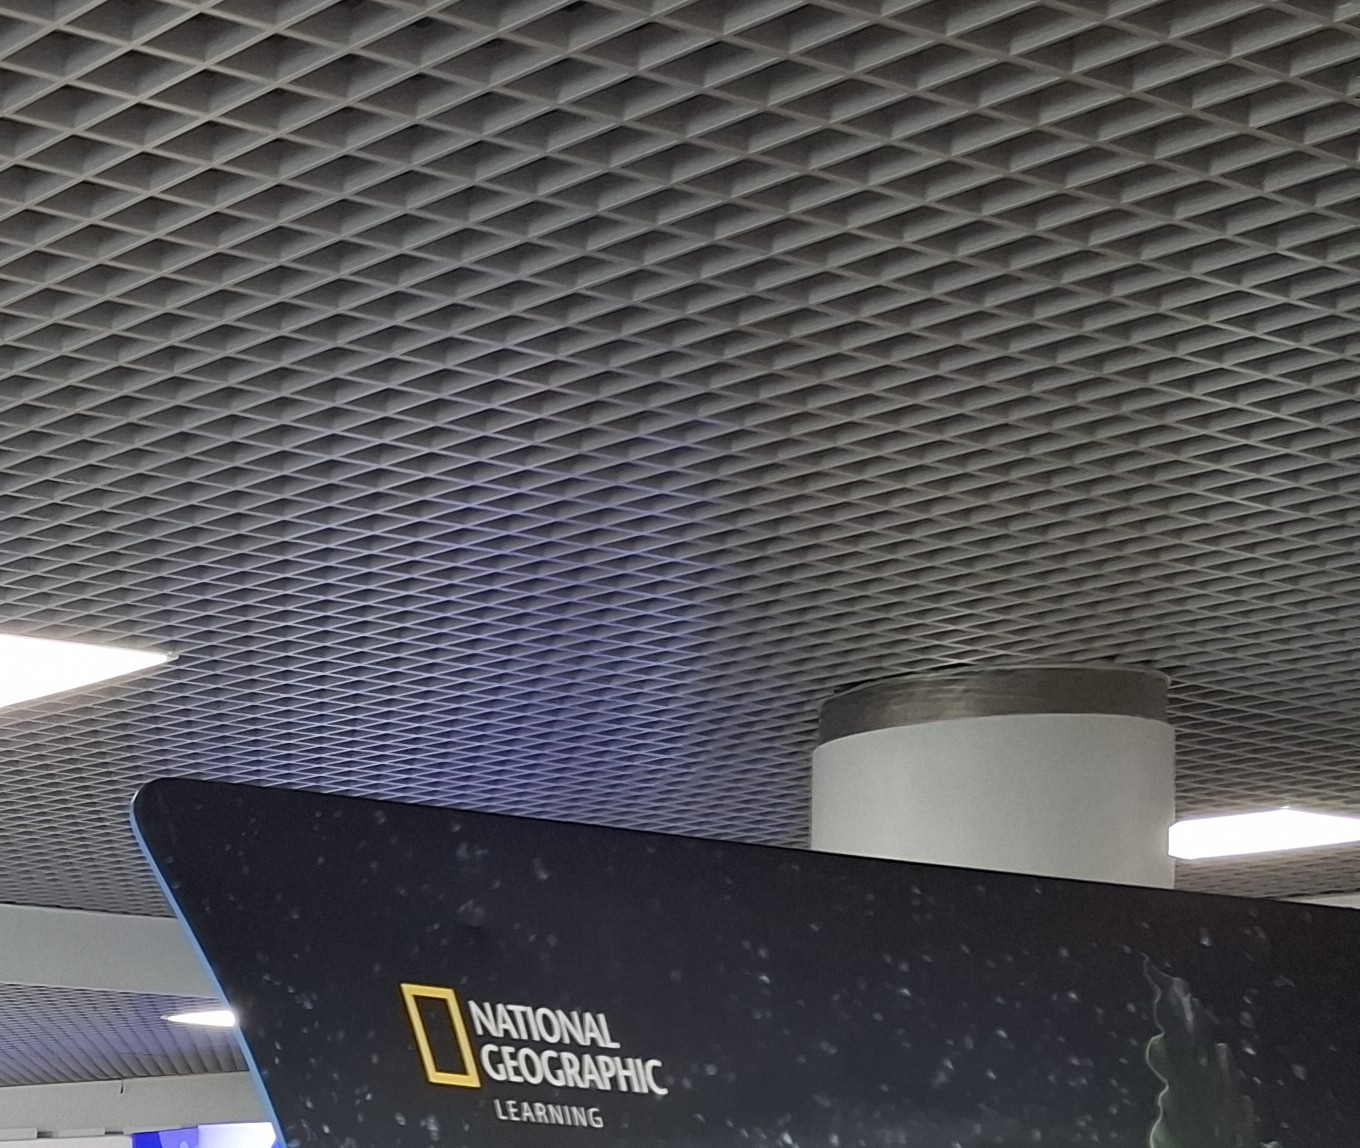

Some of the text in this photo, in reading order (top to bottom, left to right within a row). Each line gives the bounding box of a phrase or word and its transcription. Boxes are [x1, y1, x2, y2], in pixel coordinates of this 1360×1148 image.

[468, 1000, 621, 1049] NATIONAL
[480, 1044, 669, 1095] GEOGRAPHIC
[494, 1099, 604, 1128] LEARNING
